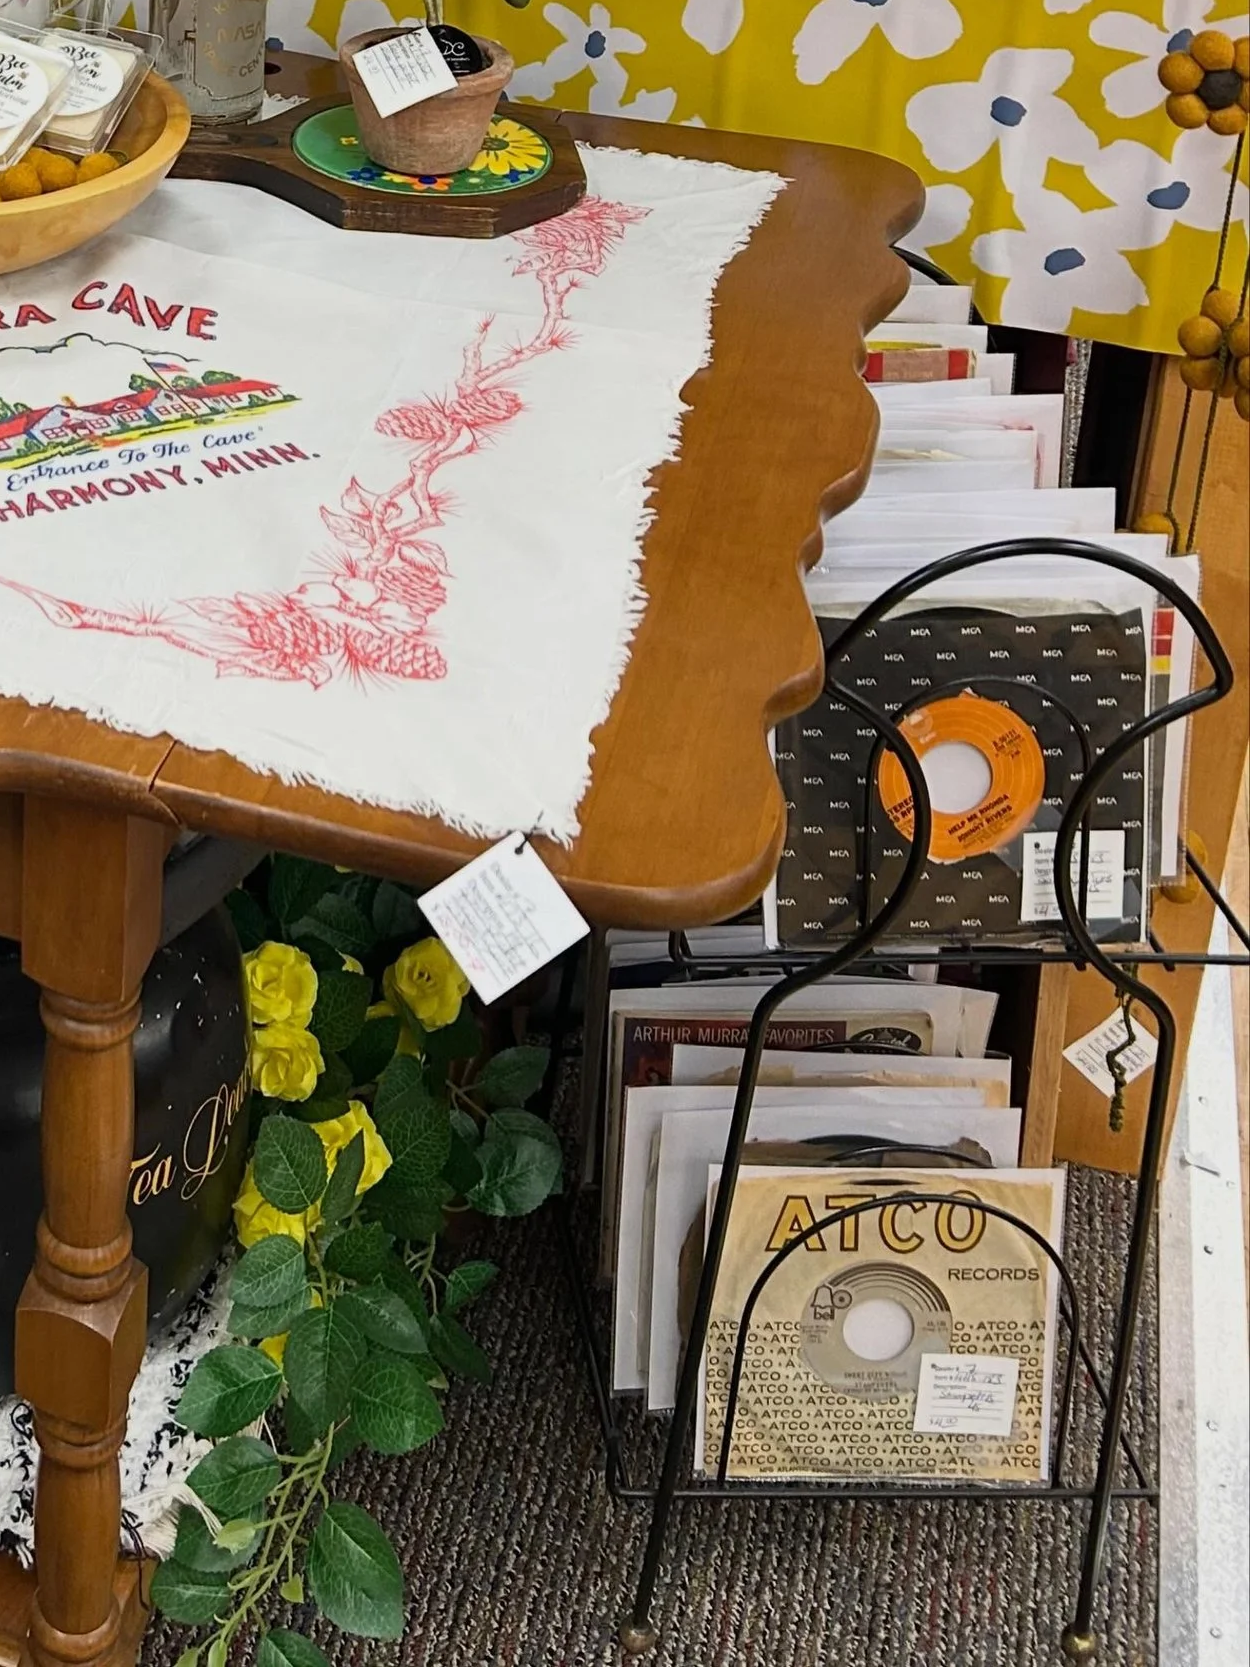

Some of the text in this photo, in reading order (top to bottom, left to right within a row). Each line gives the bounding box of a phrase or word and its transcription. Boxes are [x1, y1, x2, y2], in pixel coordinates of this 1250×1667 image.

[71, 280, 219, 341] CAVE
[201, 441, 322, 479] MINN.
[6, 458, 110, 492] Entrance
[118, 448, 149, 466] To
[151, 441, 191, 460] The
[1125, 627, 1142, 636] MCA
[1017, 675, 1036, 684] MCA
[776, 752, 795, 760] MCA
[1123, 772, 1142, 780] MCA
[887, 796, 913, 815] TERE
[948, 821, 966, 835] HELP
[979, 794, 1009, 815] RHONDA
[985, 805, 1012, 824] RIVERS
[1122, 820, 1141, 828] MCA
[1123, 868, 1140, 876] MCA
[1120, 916, 1139, 924] MCA
[632, 1025, 835, 1045] ARTHUR MURRA FAVORITES
[765, 1189, 988, 1255] ATCO
[947, 1267, 1040, 1282] RECORDS
[813, 1305, 835, 1321] bell
[710, 1320, 1018, 1332] ATC ATCO ATCO
[717, 1332, 758, 1343] ATO
[770, 1333, 800, 1344] ATC
[983, 1332, 1025, 1342] ATCO
[724, 1344, 1031, 1355] ACO TCO ATCO
[742, 1358, 773, 1369] TCO
[740, 1369, 1043, 1381] ATCO ATC TCO
[706, 1380, 732, 1391] TCO
[747, 1383, 788, 1394] ATCO
[1016, 1382, 1042, 1392] ATC
[753, 1394, 1042, 1406] ATCO ATCO ATC
[710, 1406, 908, 1419] ATO ATCO ATCO ATCO
[716, 1419, 914, 1431] ACO ATCO ATCO ATCO
[776, 1433, 818, 1444] ATCO
[829, 1434, 871, 1444] ATCO
[882, 1434, 924, 1444] ATCO
[935, 1433, 977, 1444] ATCO
[731, 1443, 1037, 1456] ATCO ATCO ATCO ATCO ATCO
[736, 1455, 1041, 1469] ATCO ATCO ATCO ATCO ATCO
